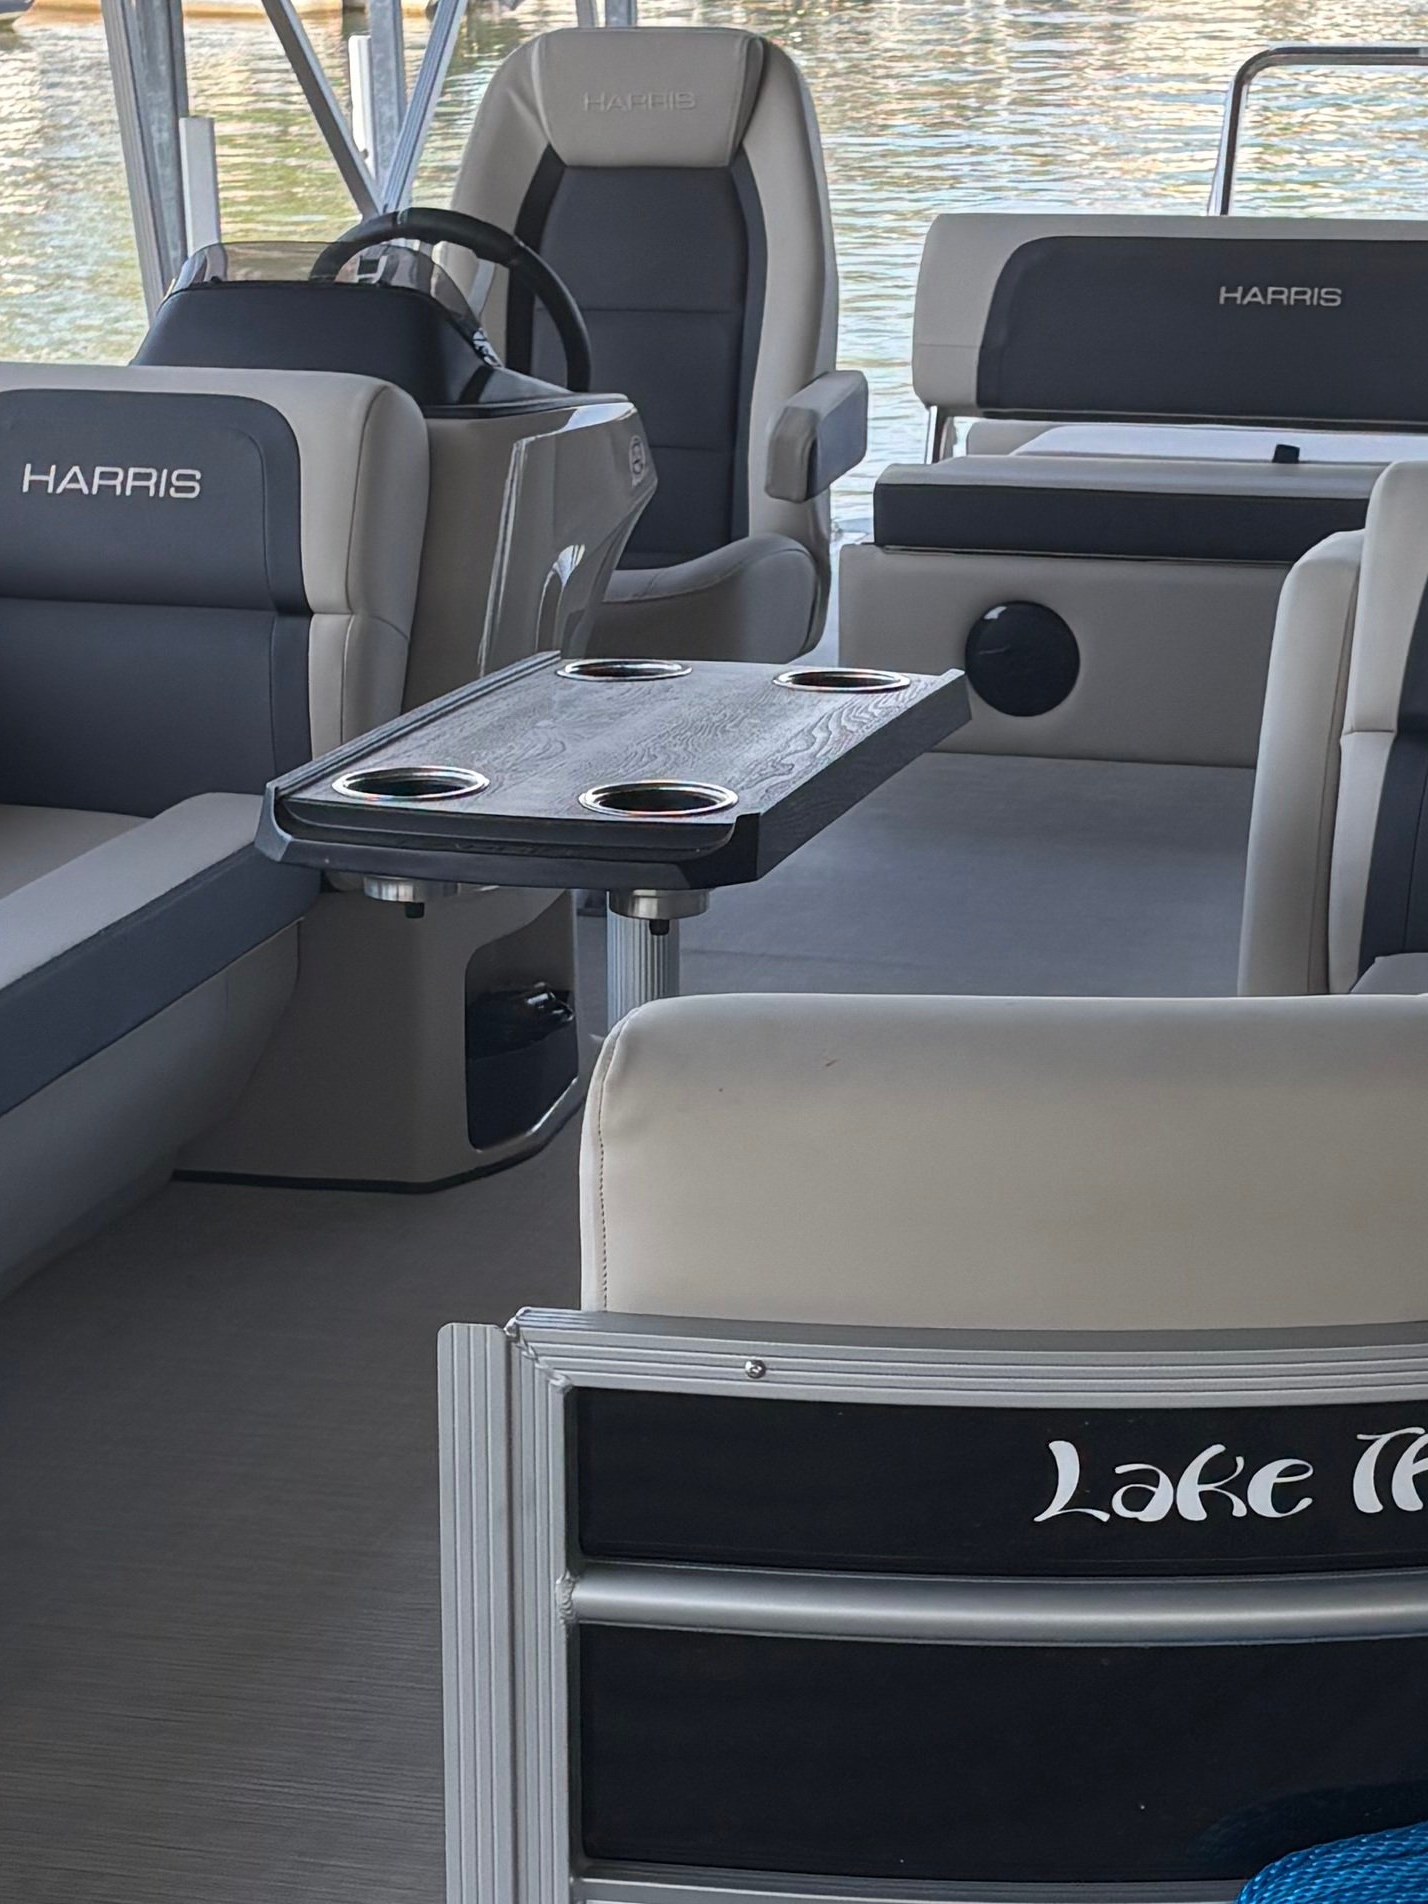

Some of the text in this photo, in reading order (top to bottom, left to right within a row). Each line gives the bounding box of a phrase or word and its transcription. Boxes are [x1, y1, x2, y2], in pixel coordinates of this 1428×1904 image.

[583, 91, 695, 112] HARRIS
[1219, 286, 1343, 307] HARRIS
[22, 463, 202, 499] HARRIS
[1033, 1440, 1314, 1523] Lake
